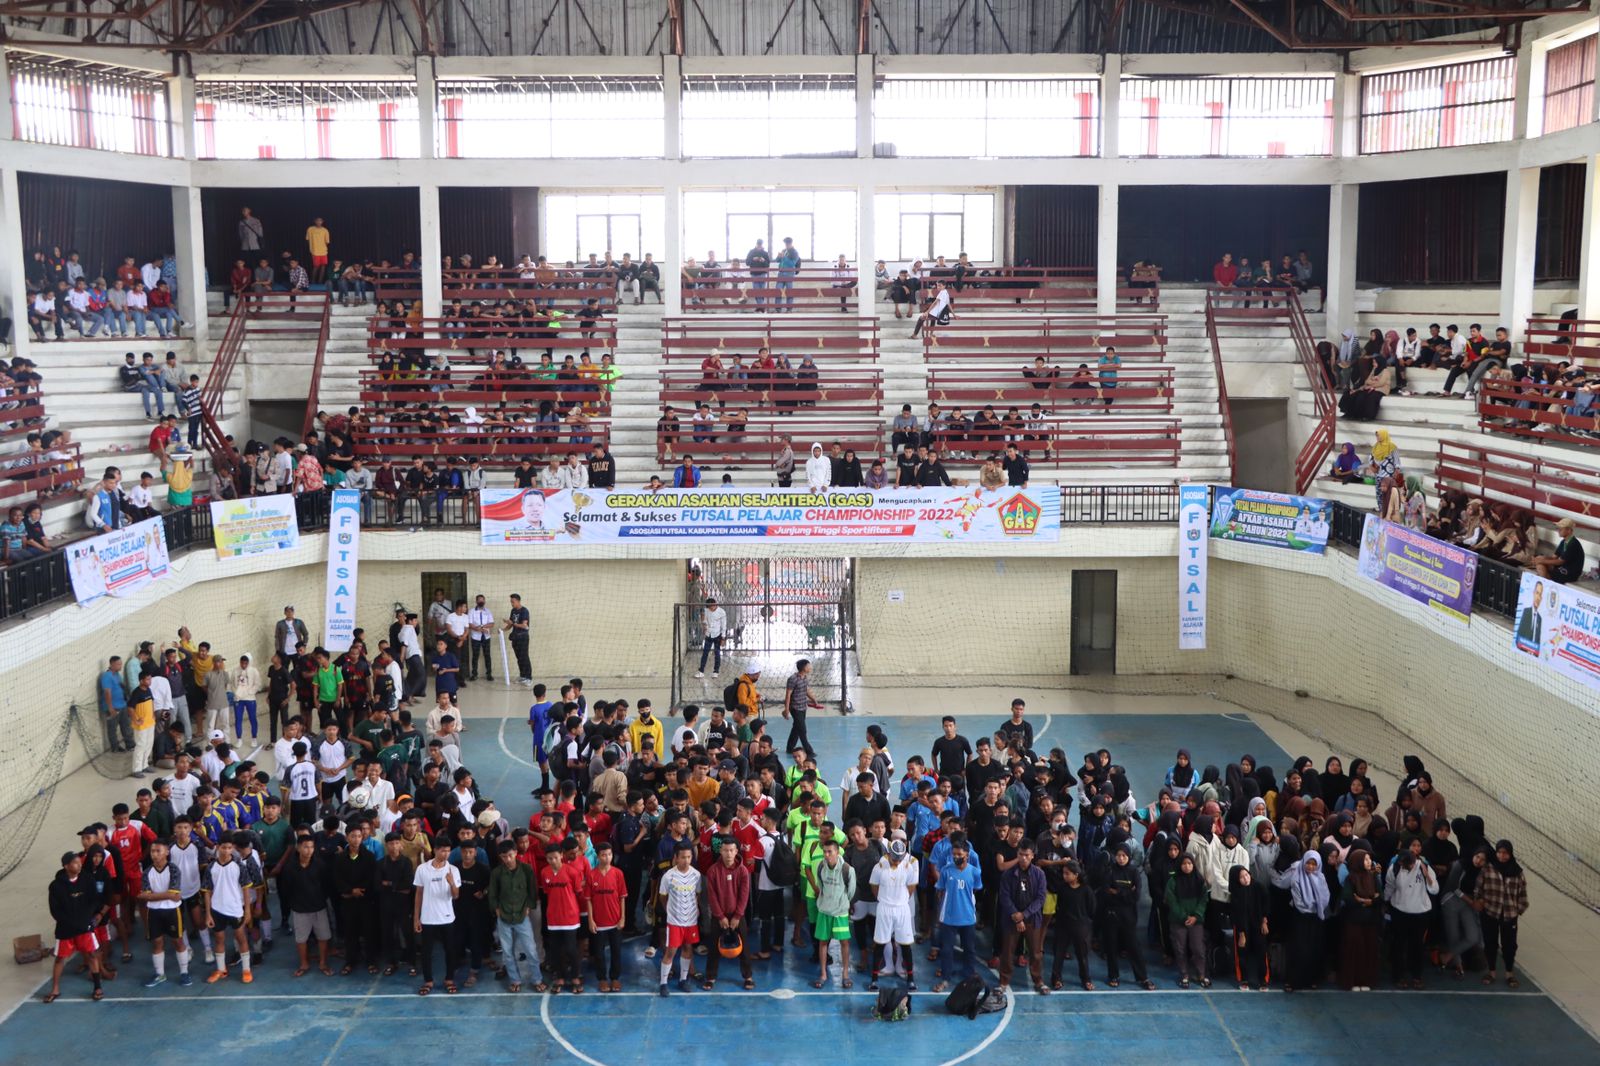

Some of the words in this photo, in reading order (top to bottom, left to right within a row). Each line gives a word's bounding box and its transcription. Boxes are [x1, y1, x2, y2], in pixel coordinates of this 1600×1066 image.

[606, 494, 678, 507] GERAKAN
[680, 493, 741, 507] ASAHAN
[742, 493, 827, 507] SEJAHTERA
[829, 493, 873, 507] (GAS)
[563, 511, 617, 522] Selamat
[620, 511, 631, 522] &
[634, 511, 677, 522] Sukses
[681, 509, 734, 521] FUTSAL
[737, 509, 802, 521] PELAJAR
[805, 508, 915, 521] CHAMPIONSHIP
[918, 508, 954, 521] 2022
[1263, 516, 1294, 529] ASAHAN
[774, 526, 811, 536] Junjung
[813, 526, 840, 536] Tinggi
[1268, 527, 1288, 538] 2022
[1560, 604, 1590, 631] FUTSAL
[301, 778, 308, 797] 9
[957, 879, 965, 890] 10
